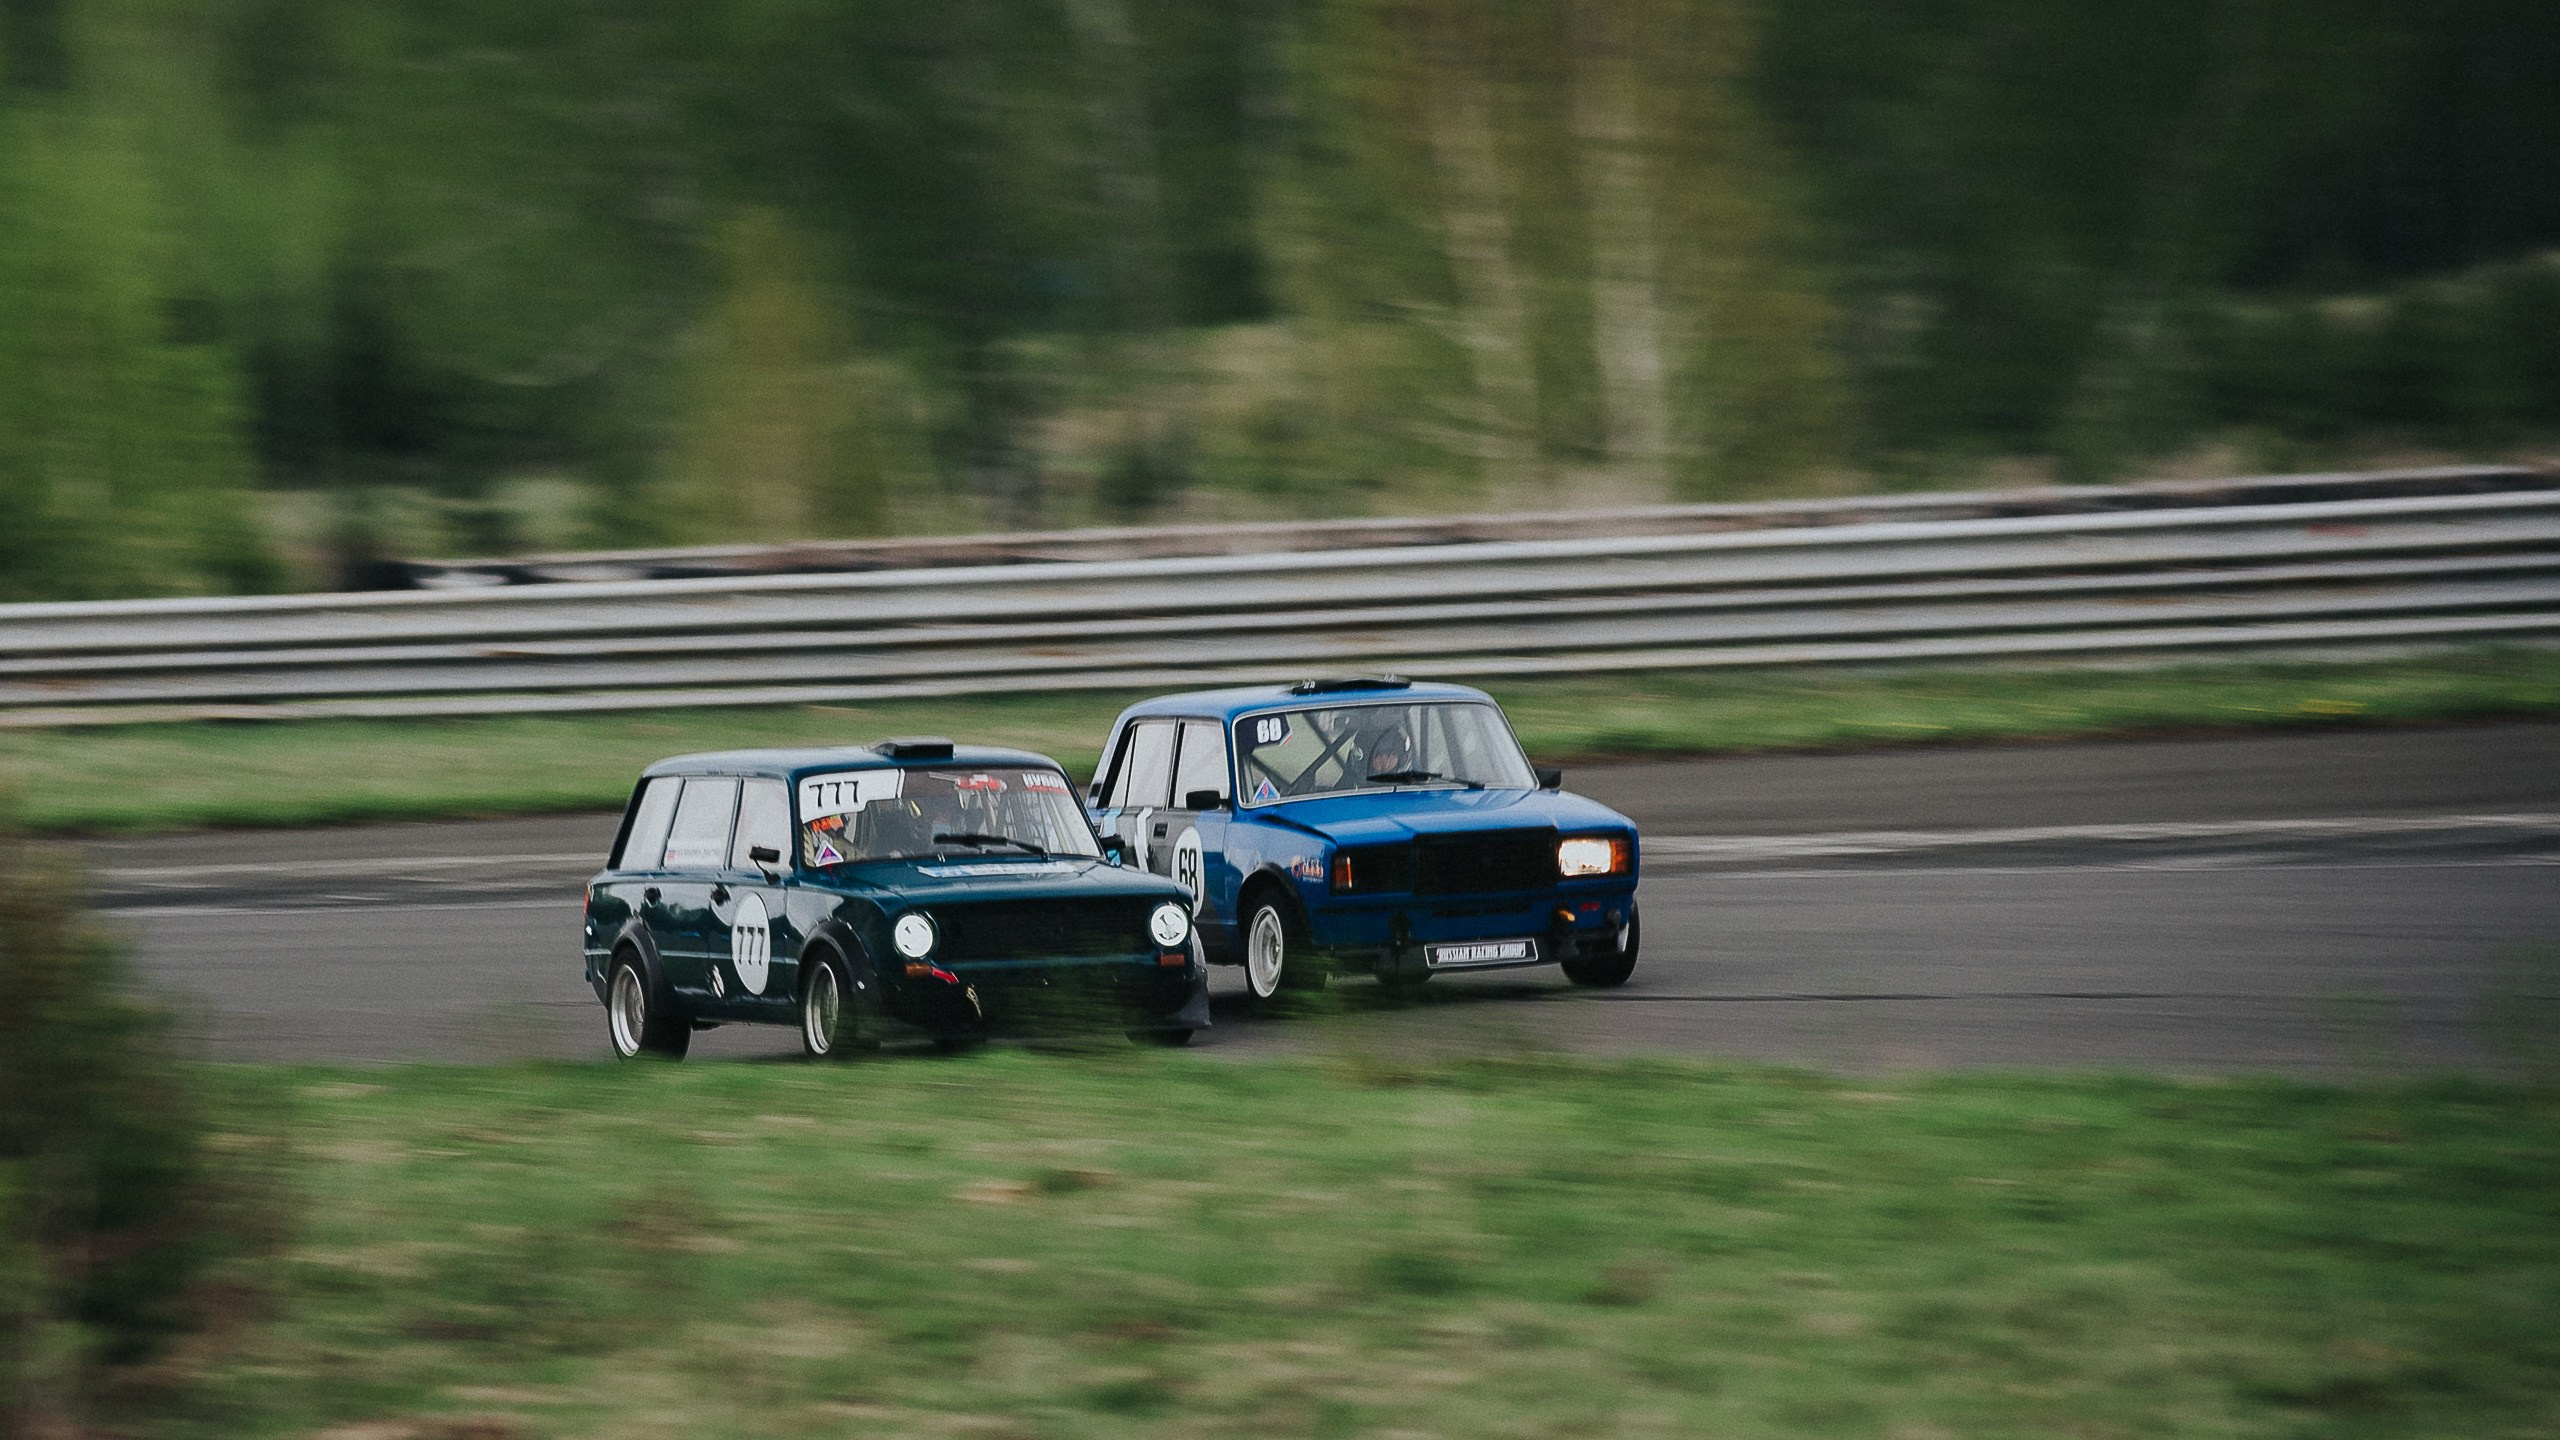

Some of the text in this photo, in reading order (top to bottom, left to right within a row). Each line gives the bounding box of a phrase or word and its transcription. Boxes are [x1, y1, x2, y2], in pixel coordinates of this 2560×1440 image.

[808, 780, 859, 808] 777
[1179, 847, 1199, 902] 68
[737, 926, 765, 966] 777
[1437, 942, 1526, 963] RUSSIAN RACING GROUP
